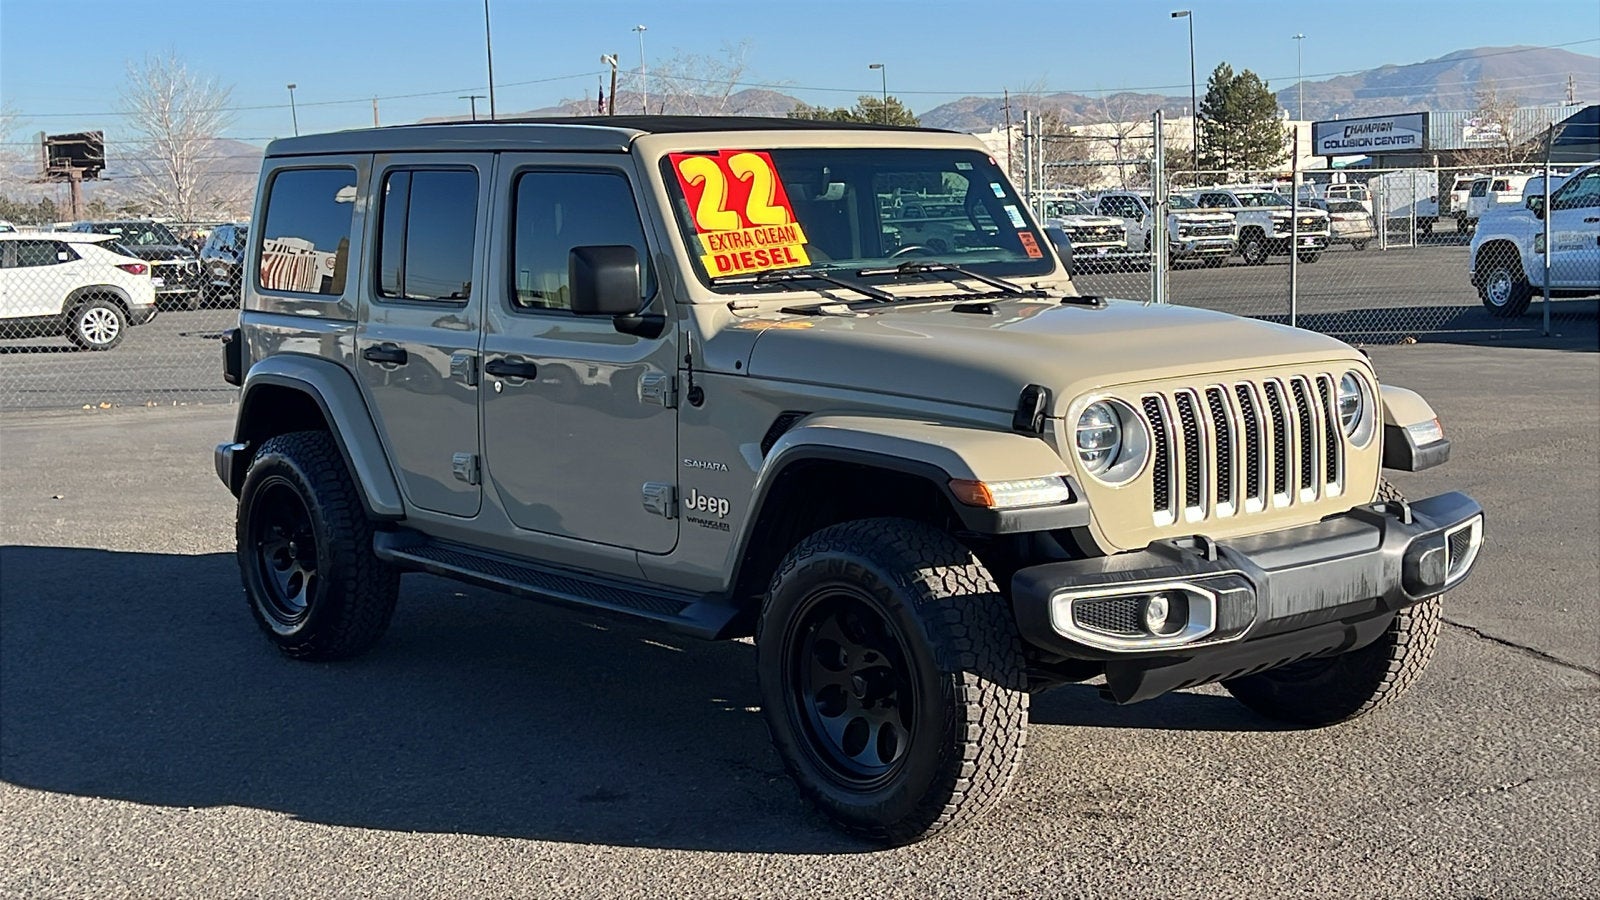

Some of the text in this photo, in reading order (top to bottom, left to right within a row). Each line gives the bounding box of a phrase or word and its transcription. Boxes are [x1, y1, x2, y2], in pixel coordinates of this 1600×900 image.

[1324, 134, 1415, 149] COLLISION CENTER
[1344, 122, 1393, 138] CHAMPION
[679, 153, 790, 231] 22
[708, 226, 797, 251] EXTRA CLEAN
[714, 247, 798, 272] DIESEL
[684, 459, 730, 472] SAHARA
[685, 488, 730, 518] Jeep
